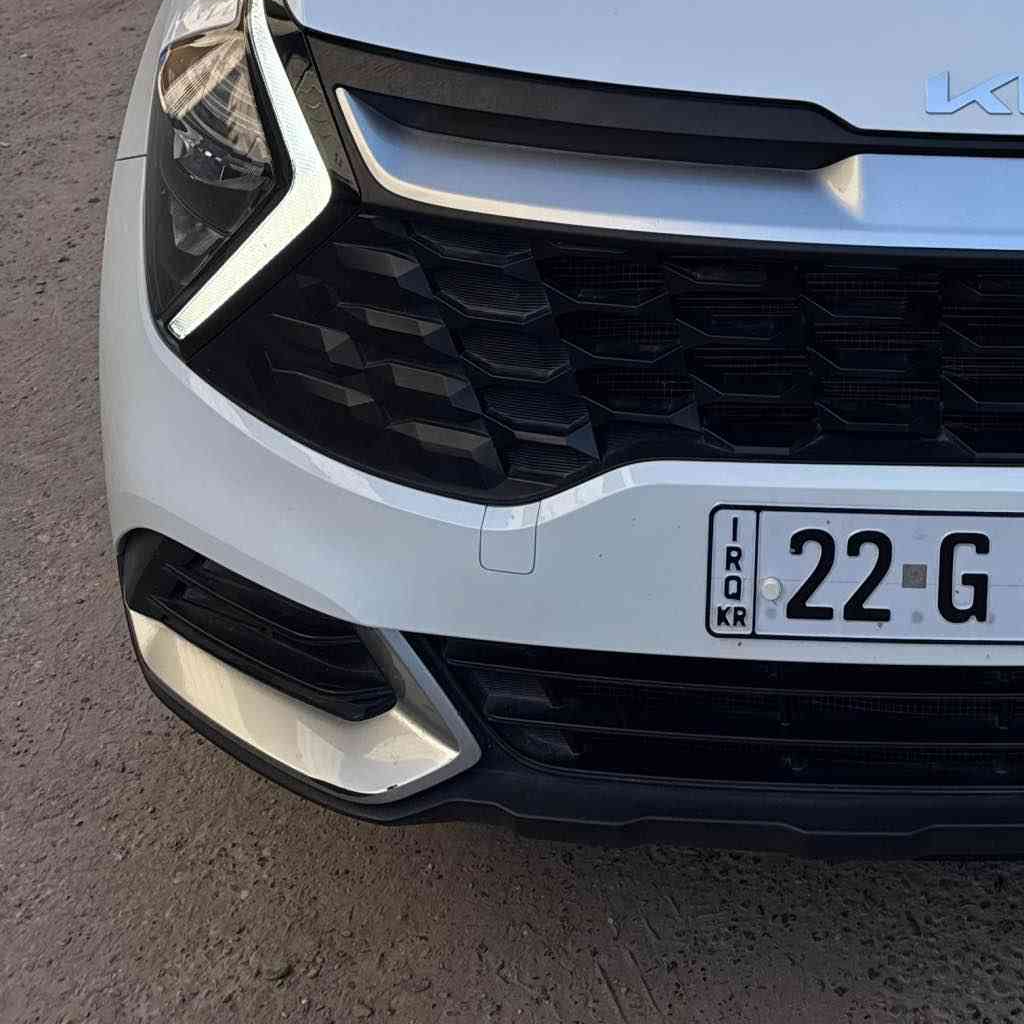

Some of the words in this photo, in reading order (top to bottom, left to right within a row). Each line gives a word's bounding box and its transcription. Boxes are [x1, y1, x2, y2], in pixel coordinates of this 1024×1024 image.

[785, 527, 893, 623] 22
[938, 531, 991, 624] G
[716, 605, 748, 629] KR
